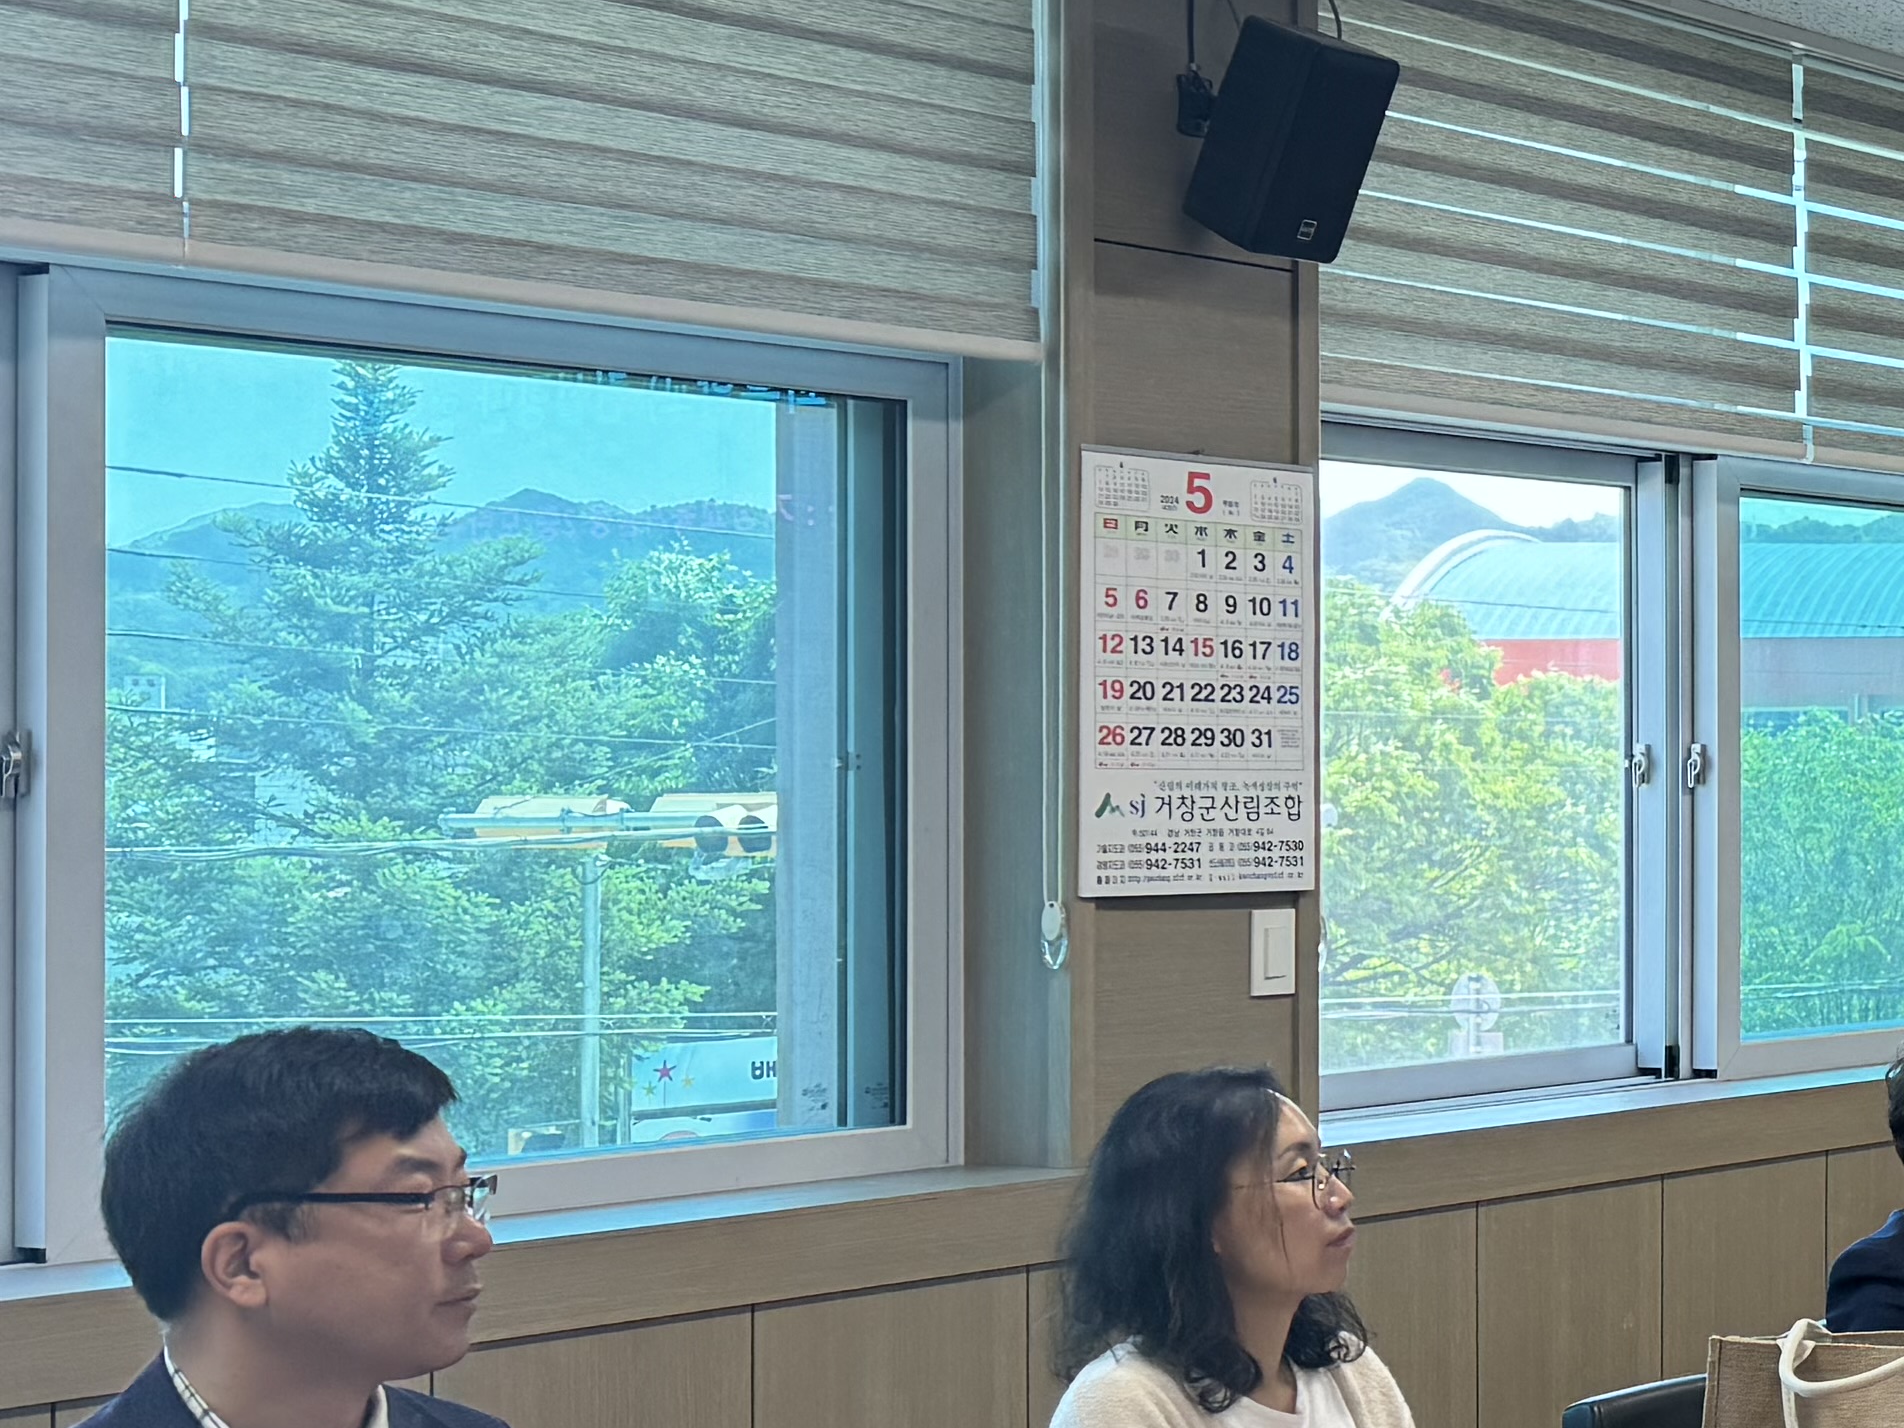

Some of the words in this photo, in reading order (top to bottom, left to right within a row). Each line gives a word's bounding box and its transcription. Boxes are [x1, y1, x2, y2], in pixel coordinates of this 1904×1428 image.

[1185, 471, 1213, 514] 5
[1164, 523, 1179, 535] 火
[1194, 525, 1208, 537] 水
[1223, 528, 1238, 540] 木
[1253, 530, 1266, 542] 金
[1281, 532, 1295, 544] 土
[1196, 548, 1206, 568] 1
[1224, 550, 1237, 570] 2
[1253, 552, 1267, 572] 3
[1281, 555, 1294, 574] 4
[1104, 587, 1118, 608] 5
[1134, 588, 1149, 610] 6
[1165, 591, 1179, 611] 7
[1195, 592, 1209, 613] 8
[1224, 595, 1238, 614] 9
[1248, 596, 1272, 616] 10
[1278, 598, 1299, 618] 11
[1098, 633, 1124, 654] 12
[1129, 634, 1154, 655] 13
[1160, 635, 1185, 657] 14
[1190, 637, 1214, 658] 15
[1219, 639, 1244, 659] 16
[1248, 640, 1272, 660] 17
[1277, 641, 1300, 661] 18
[1098, 679, 1124, 700] 19
[1129, 680, 1155, 700] 20
[1161, 681, 1185, 702] 21
[1190, 682, 1216, 703] 22
[1219, 684, 1245, 703] 23
[1248, 685, 1272, 704] 24
[1276, 685, 1300, 705] 25
[1098, 724, 1125, 746] 26
[1129, 726, 1156, 746] 27
[1160, 726, 1186, 747] 28
[1190, 727, 1216, 747] 29
[1219, 728, 1245, 748] 30
[1250, 728, 1272, 749] 31
[1153, 793, 1304, 823] 거창군산림조합
[1145, 841, 1202, 854] 944-2247
[1253, 840, 1304, 852] 942-7530
[1145, 858, 1202, 870] 942-7531
[1253, 856, 1304, 868] 942-7531
